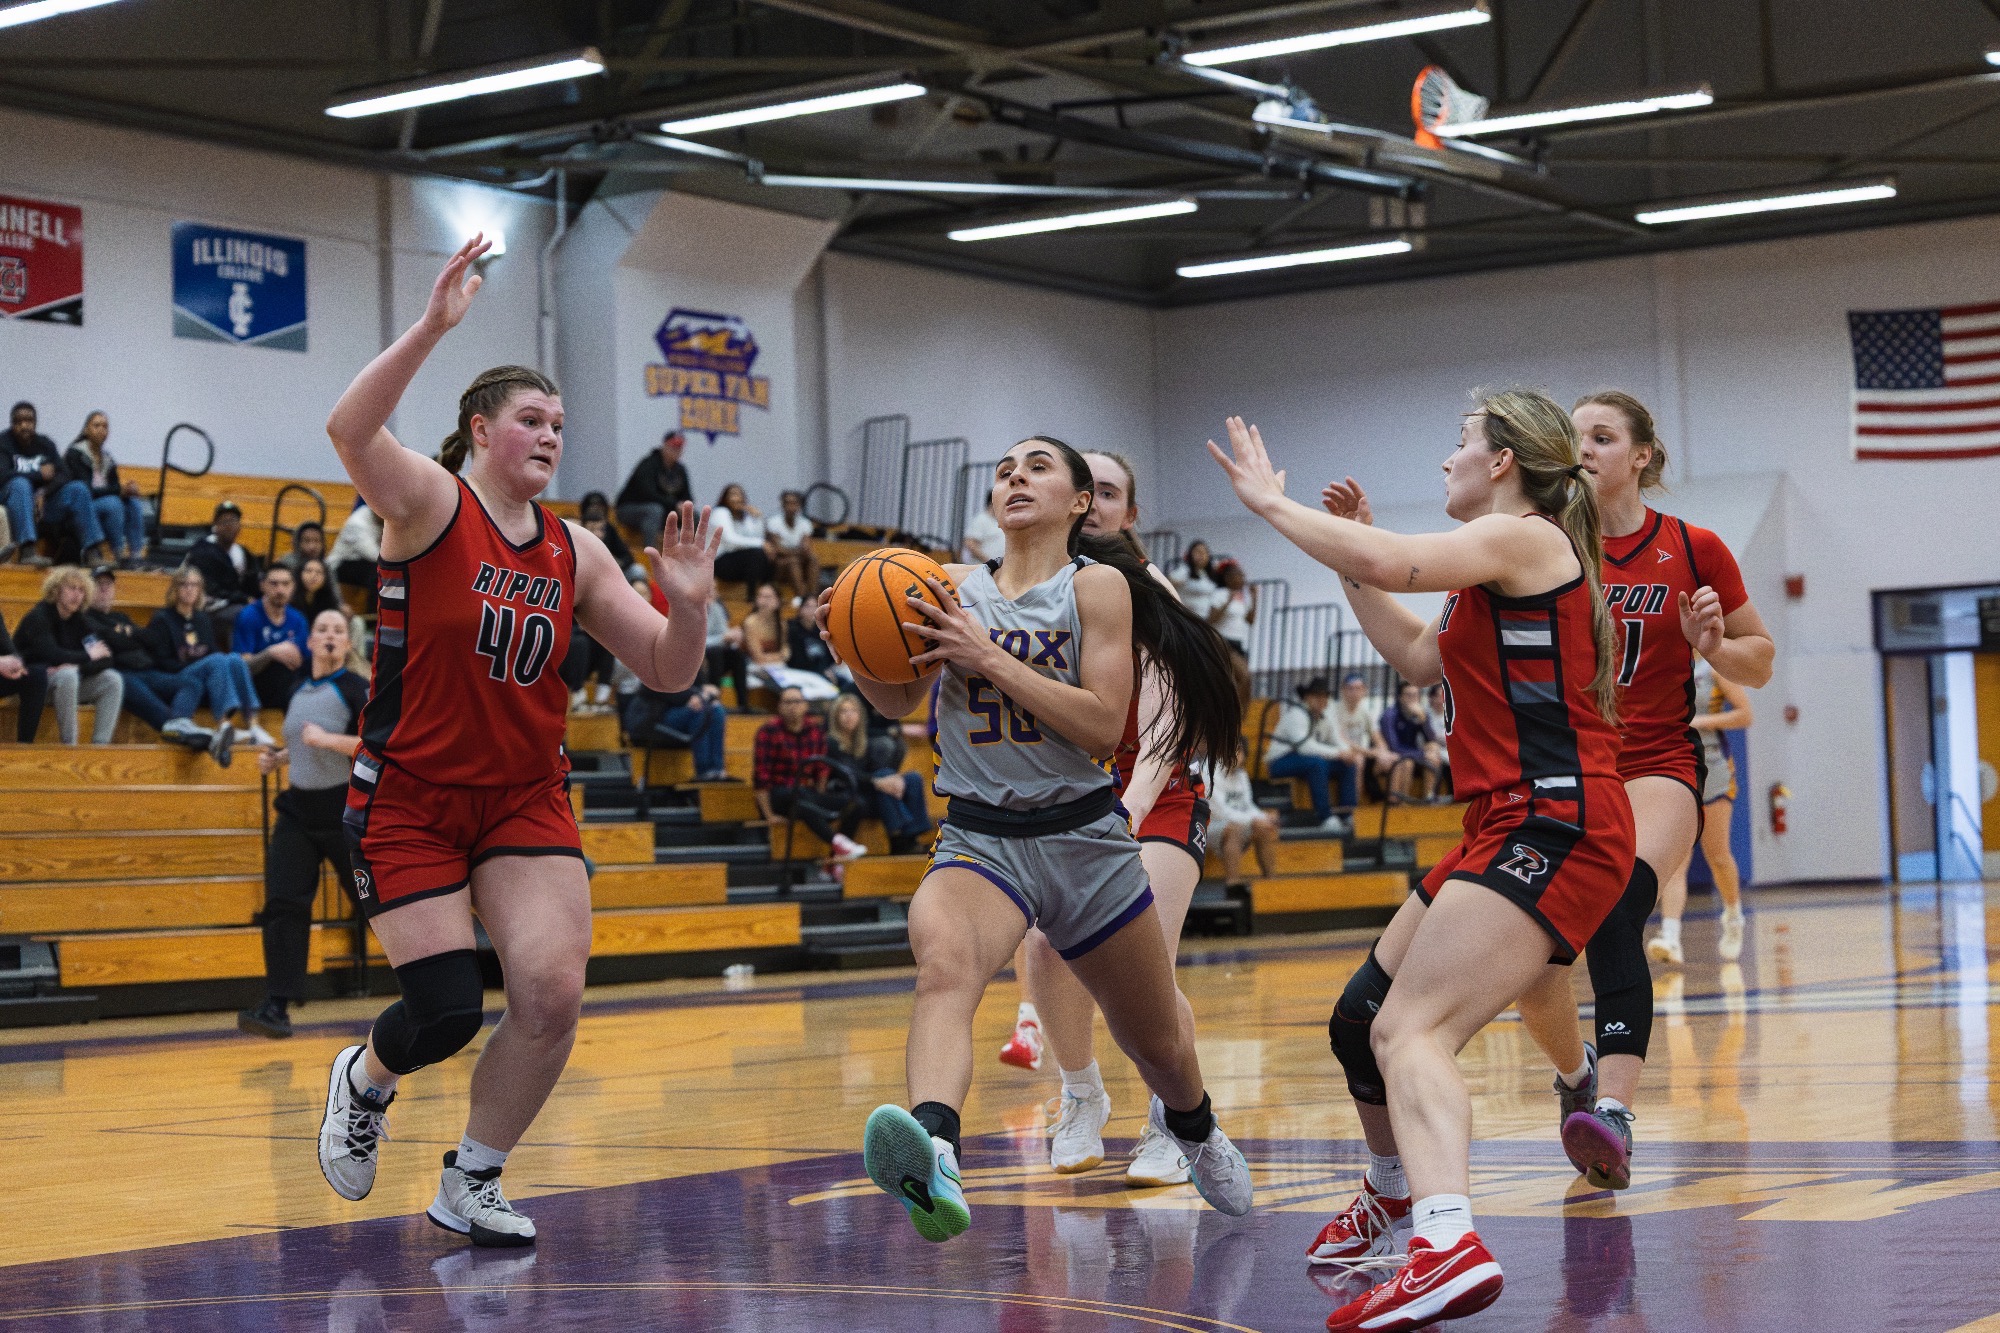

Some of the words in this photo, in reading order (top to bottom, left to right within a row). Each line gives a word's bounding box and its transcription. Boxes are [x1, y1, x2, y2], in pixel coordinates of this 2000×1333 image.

[192, 238, 288, 277] ILLINOIS
[471, 560, 562, 612] RIPON
[1602, 584, 1669, 614] PON
[475, 599, 555, 687] 40
[988, 627, 1071, 671] OX
